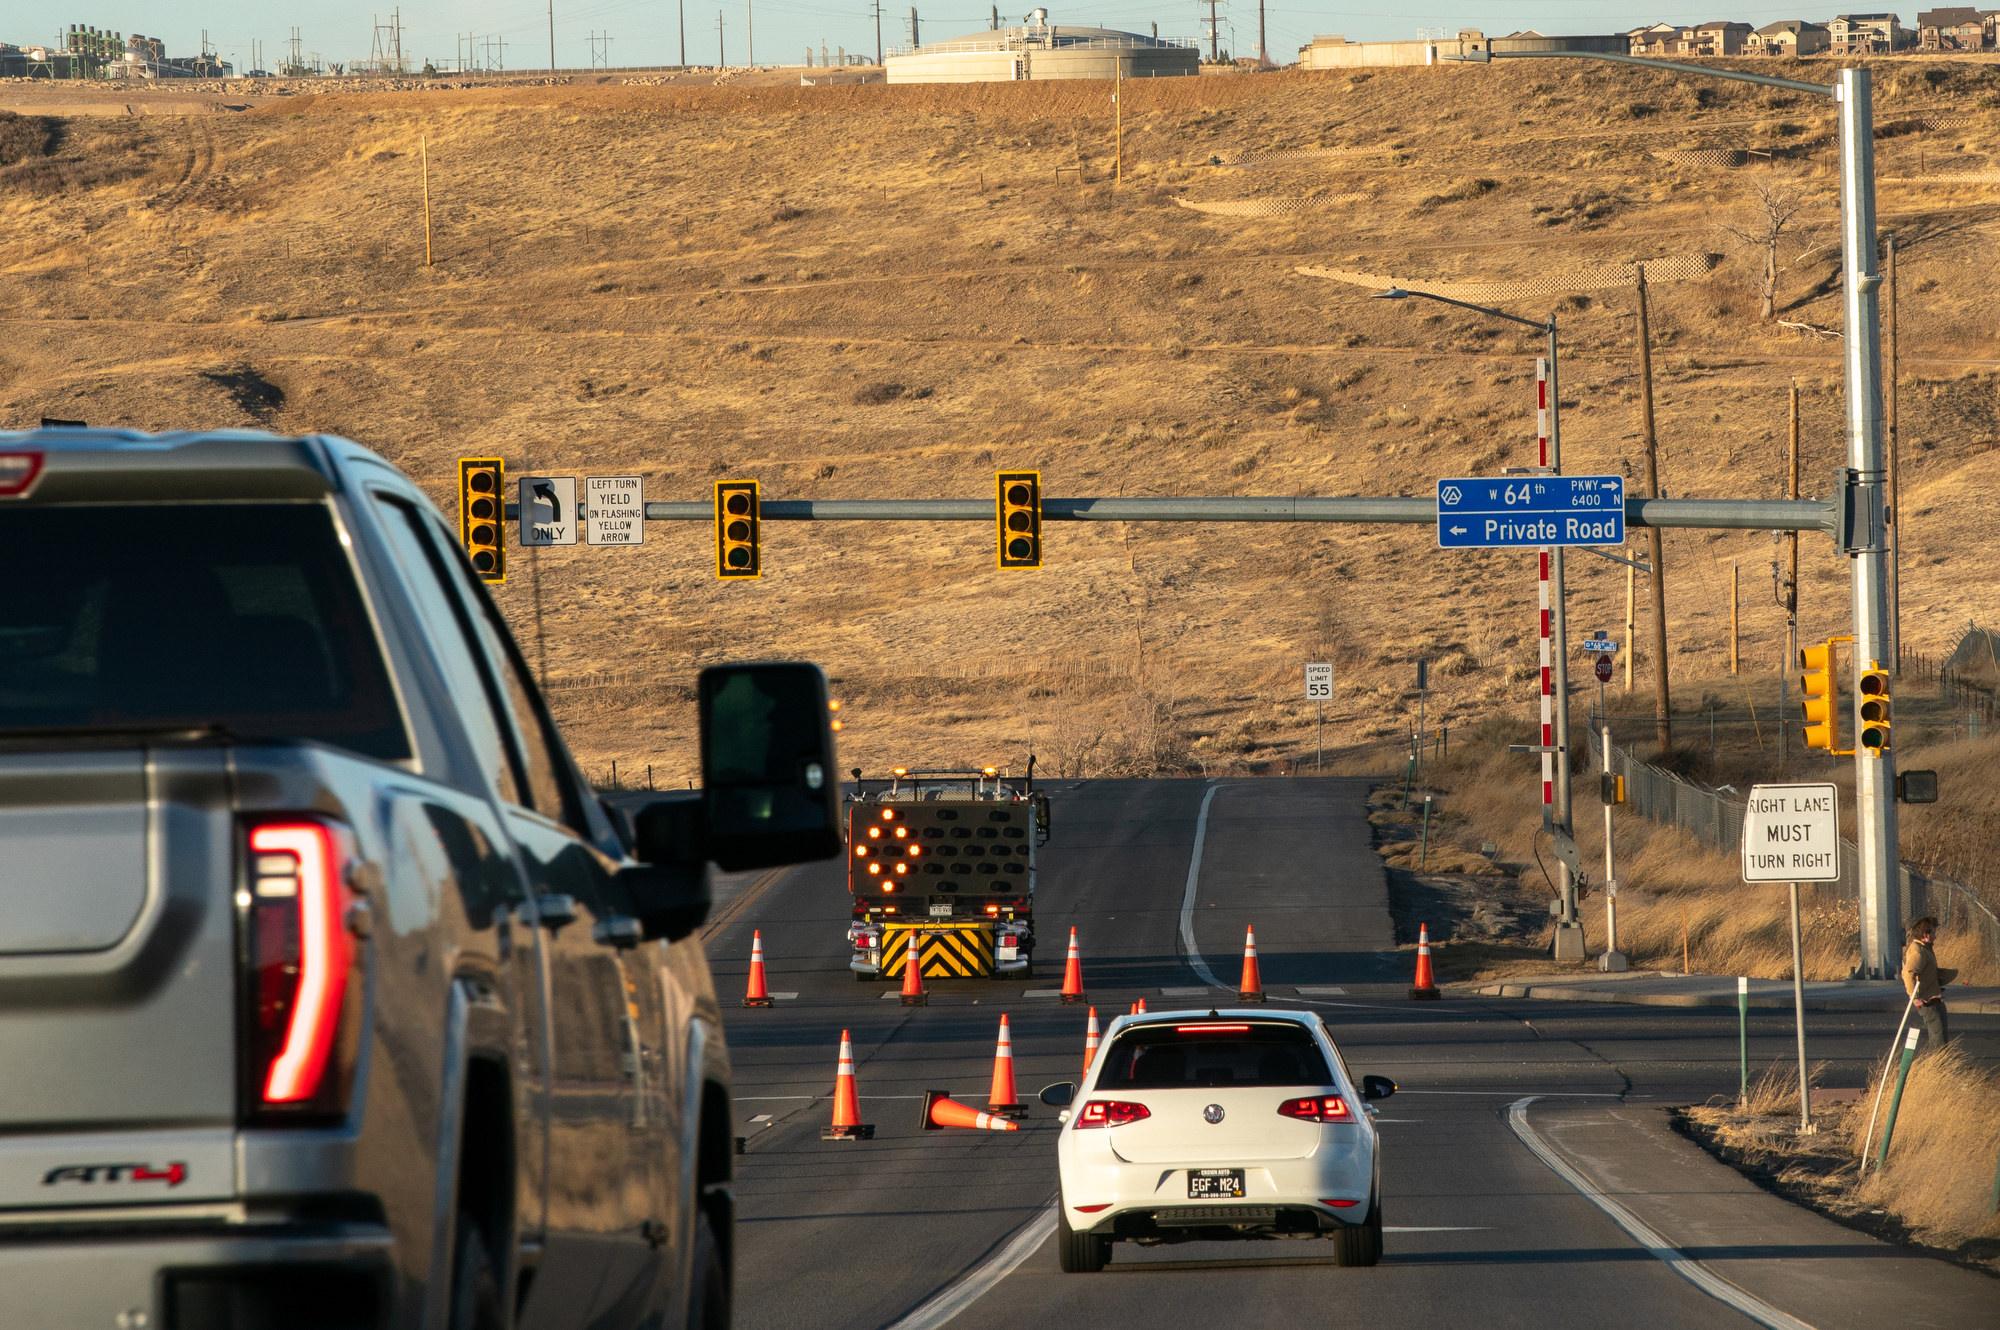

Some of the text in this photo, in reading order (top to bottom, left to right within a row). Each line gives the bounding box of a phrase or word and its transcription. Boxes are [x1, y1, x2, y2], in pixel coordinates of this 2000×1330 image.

[592, 480, 637, 489] LEFT TURN
[1489, 480, 1599, 505] W 64th PKWY
[600, 494, 630, 504] YIELD
[1571, 494, 1621, 506] 6400 N
[590, 509, 640, 518] ON FLASHING
[599, 521, 632, 530] YELLOW
[1485, 517, 1616, 540] Private Road
[531, 527, 565, 540] ONLY
[601, 533, 630, 542] ARROW
[1309, 684, 1329, 696] 55
[1749, 797, 1830, 813] RIGHT LANE
[1767, 824, 1812, 842] MUST
[1750, 853, 1832, 869] TURN RIGHT
